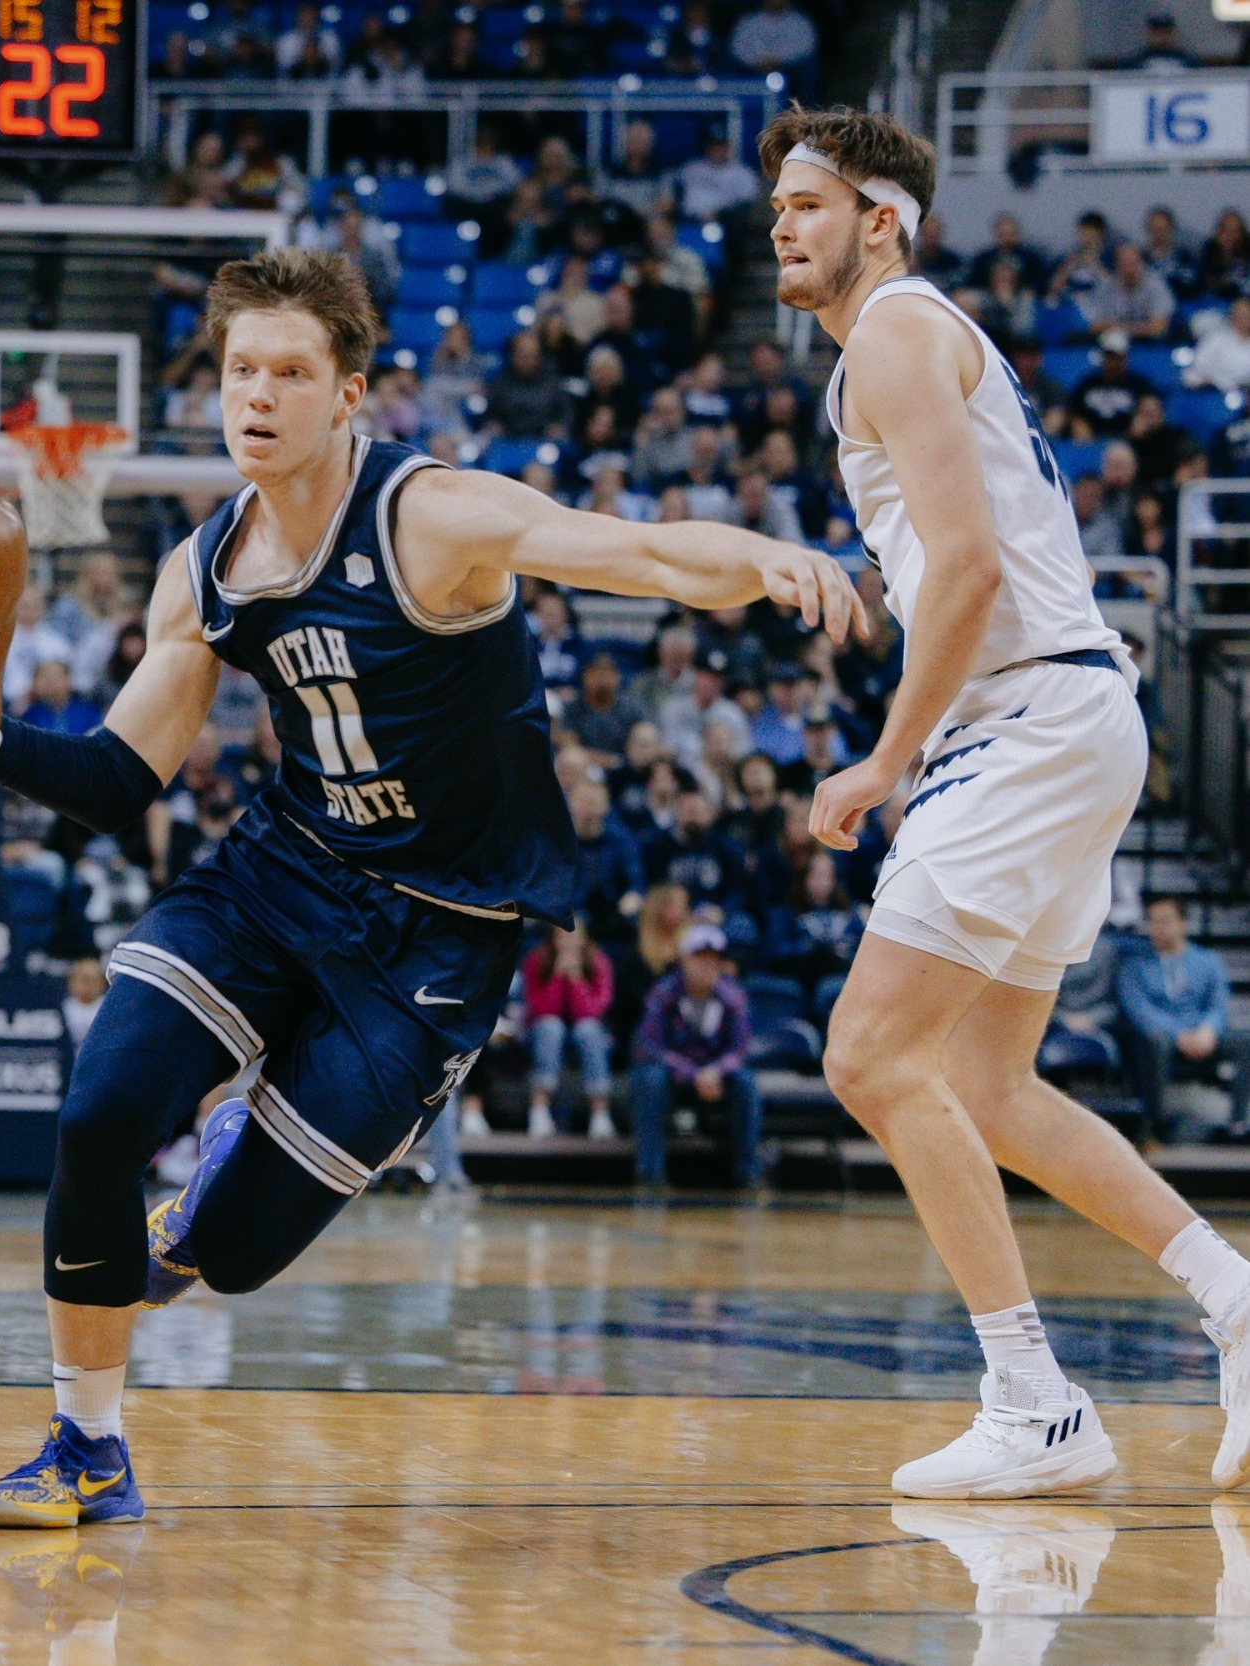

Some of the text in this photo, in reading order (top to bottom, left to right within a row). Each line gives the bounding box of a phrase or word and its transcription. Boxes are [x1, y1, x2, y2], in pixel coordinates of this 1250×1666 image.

[75, 0, 122, 44] 12
[1144, 91, 1210, 146] 16
[266, 626, 358, 688] UTAH
[294, 682, 380, 776] 11
[320, 775, 417, 826] STATE
